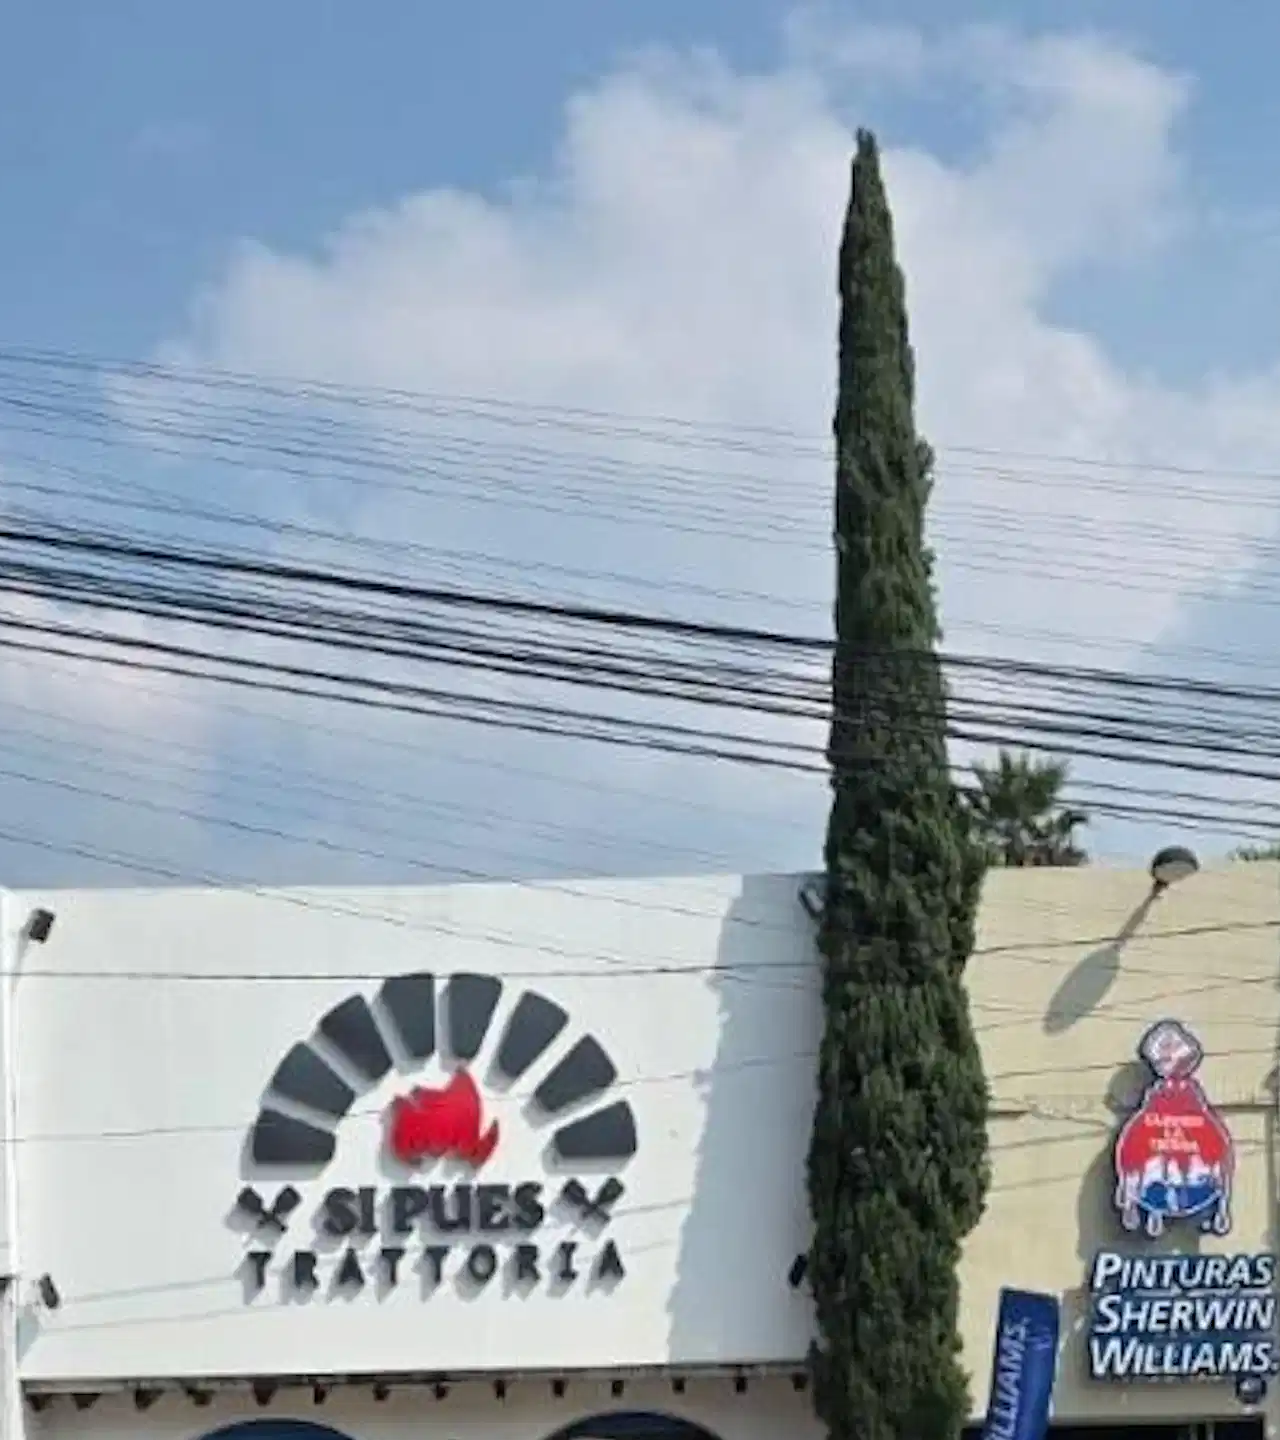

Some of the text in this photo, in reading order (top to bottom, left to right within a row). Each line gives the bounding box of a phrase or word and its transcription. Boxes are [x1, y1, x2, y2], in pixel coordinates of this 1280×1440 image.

[390, 1182, 544, 1234] PUES
[247, 1238, 626, 1288] TRATTORIA
[1092, 1252, 1274, 1291] PINTURAS
[1093, 1295, 1275, 1334] SHERWIN
